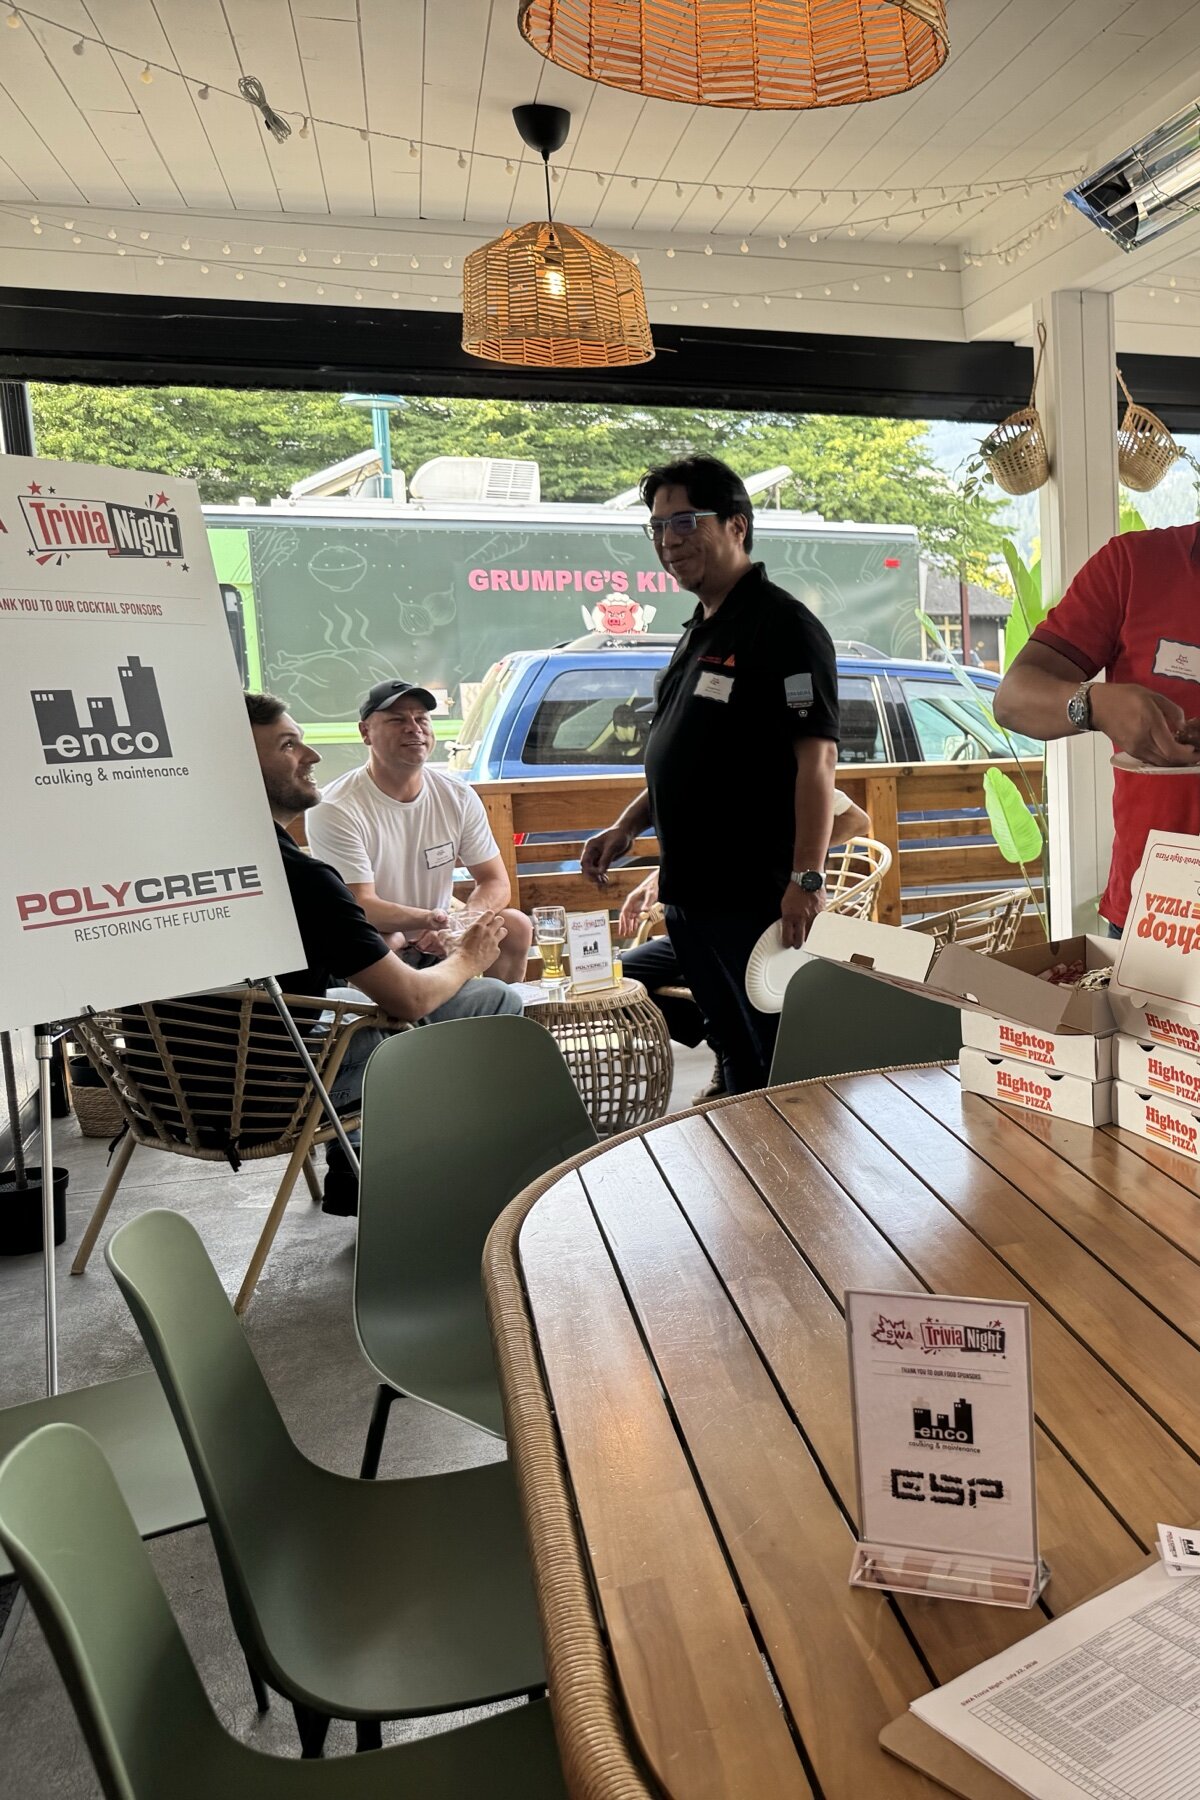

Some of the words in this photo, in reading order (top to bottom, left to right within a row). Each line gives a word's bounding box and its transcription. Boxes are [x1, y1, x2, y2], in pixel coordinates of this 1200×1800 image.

[29, 502, 110, 545] Trivia
[112, 508, 178, 557] Night
[468, 569, 629, 592] GRUMPIG'S
[637, 571, 680, 592] KIT
[18, 598, 39, 611] YOU
[40, 599, 53, 612] TO
[55, 600, 75, 613] OUR
[77, 601, 119, 615] COCKTAIL
[121, 603, 163, 616] SPONSORS
[55, 731, 160, 757] enco
[35, 769, 93, 786] caulking
[97, 768, 108, 781] &
[113, 765, 189, 781] maintenance
[1155, 852, 1170, 862] Pizza
[16, 865, 262, 921] POLYCRETE
[1145, 892, 1192, 918] PIZZA
[75, 918, 152, 942] RESTORING
[154, 913, 180, 929] THE
[183, 906, 231, 926] FUTURE
[999, 1025, 1055, 1054] Hightop
[1145, 1012, 1199, 1042] Hightop
[1028, 1049, 1055, 1065] PIZZA
[997, 1071, 1052, 1100] Hightop
[1025, 1095, 1053, 1112] PIZZA
[1145, 1105, 1197, 1142] Hightop
[1171, 1134, 1198, 1155] PIZZA
[886, 1330, 914, 1340] SWA
[925, 1325, 963, 1346] Trivia
[967, 1328, 1002, 1351] Night
[957, 1371, 982, 1380] SPONSORS
[919, 1426, 968, 1442] enco
